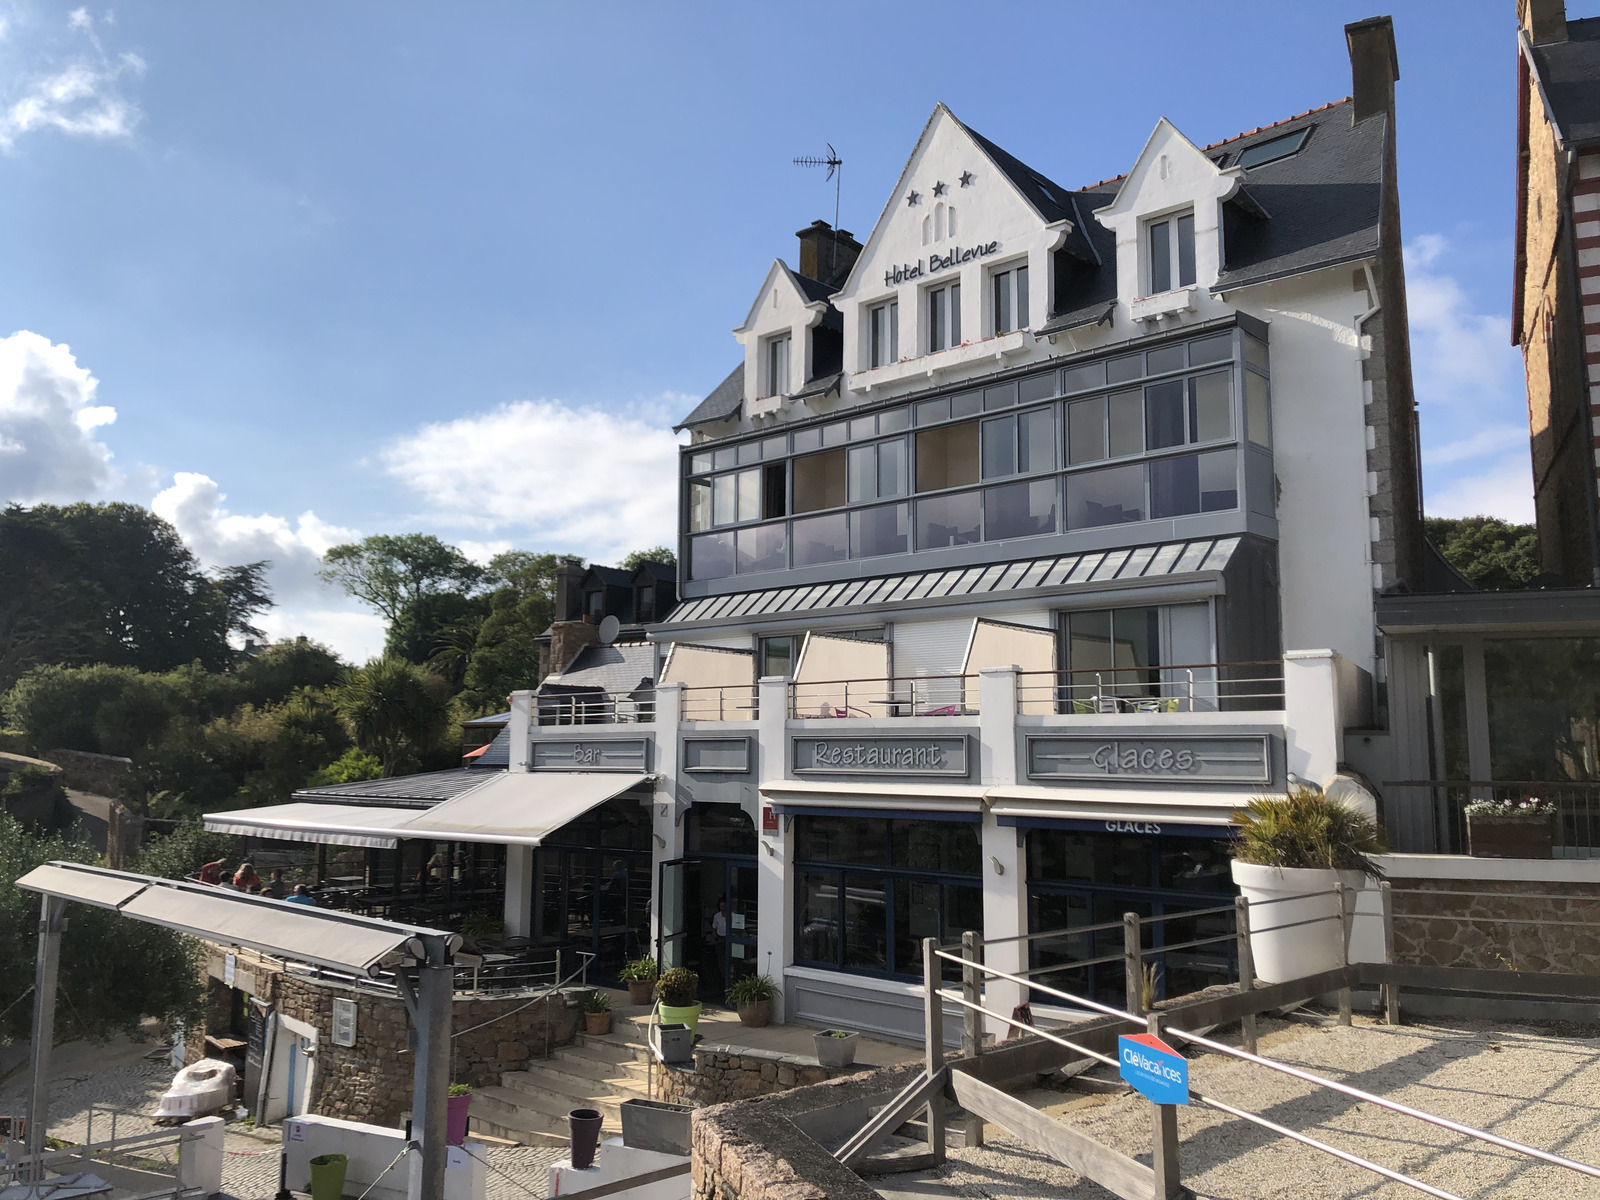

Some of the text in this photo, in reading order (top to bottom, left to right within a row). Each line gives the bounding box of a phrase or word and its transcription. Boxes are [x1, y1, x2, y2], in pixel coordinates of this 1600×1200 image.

[884, 240, 997, 287] Hotel Bellevue
[573, 743, 600, 763] Bar
[814, 741, 942, 765] Restaurant
[1093, 741, 1194, 774] Glaces
[1105, 820, 1161, 834] GLACES
